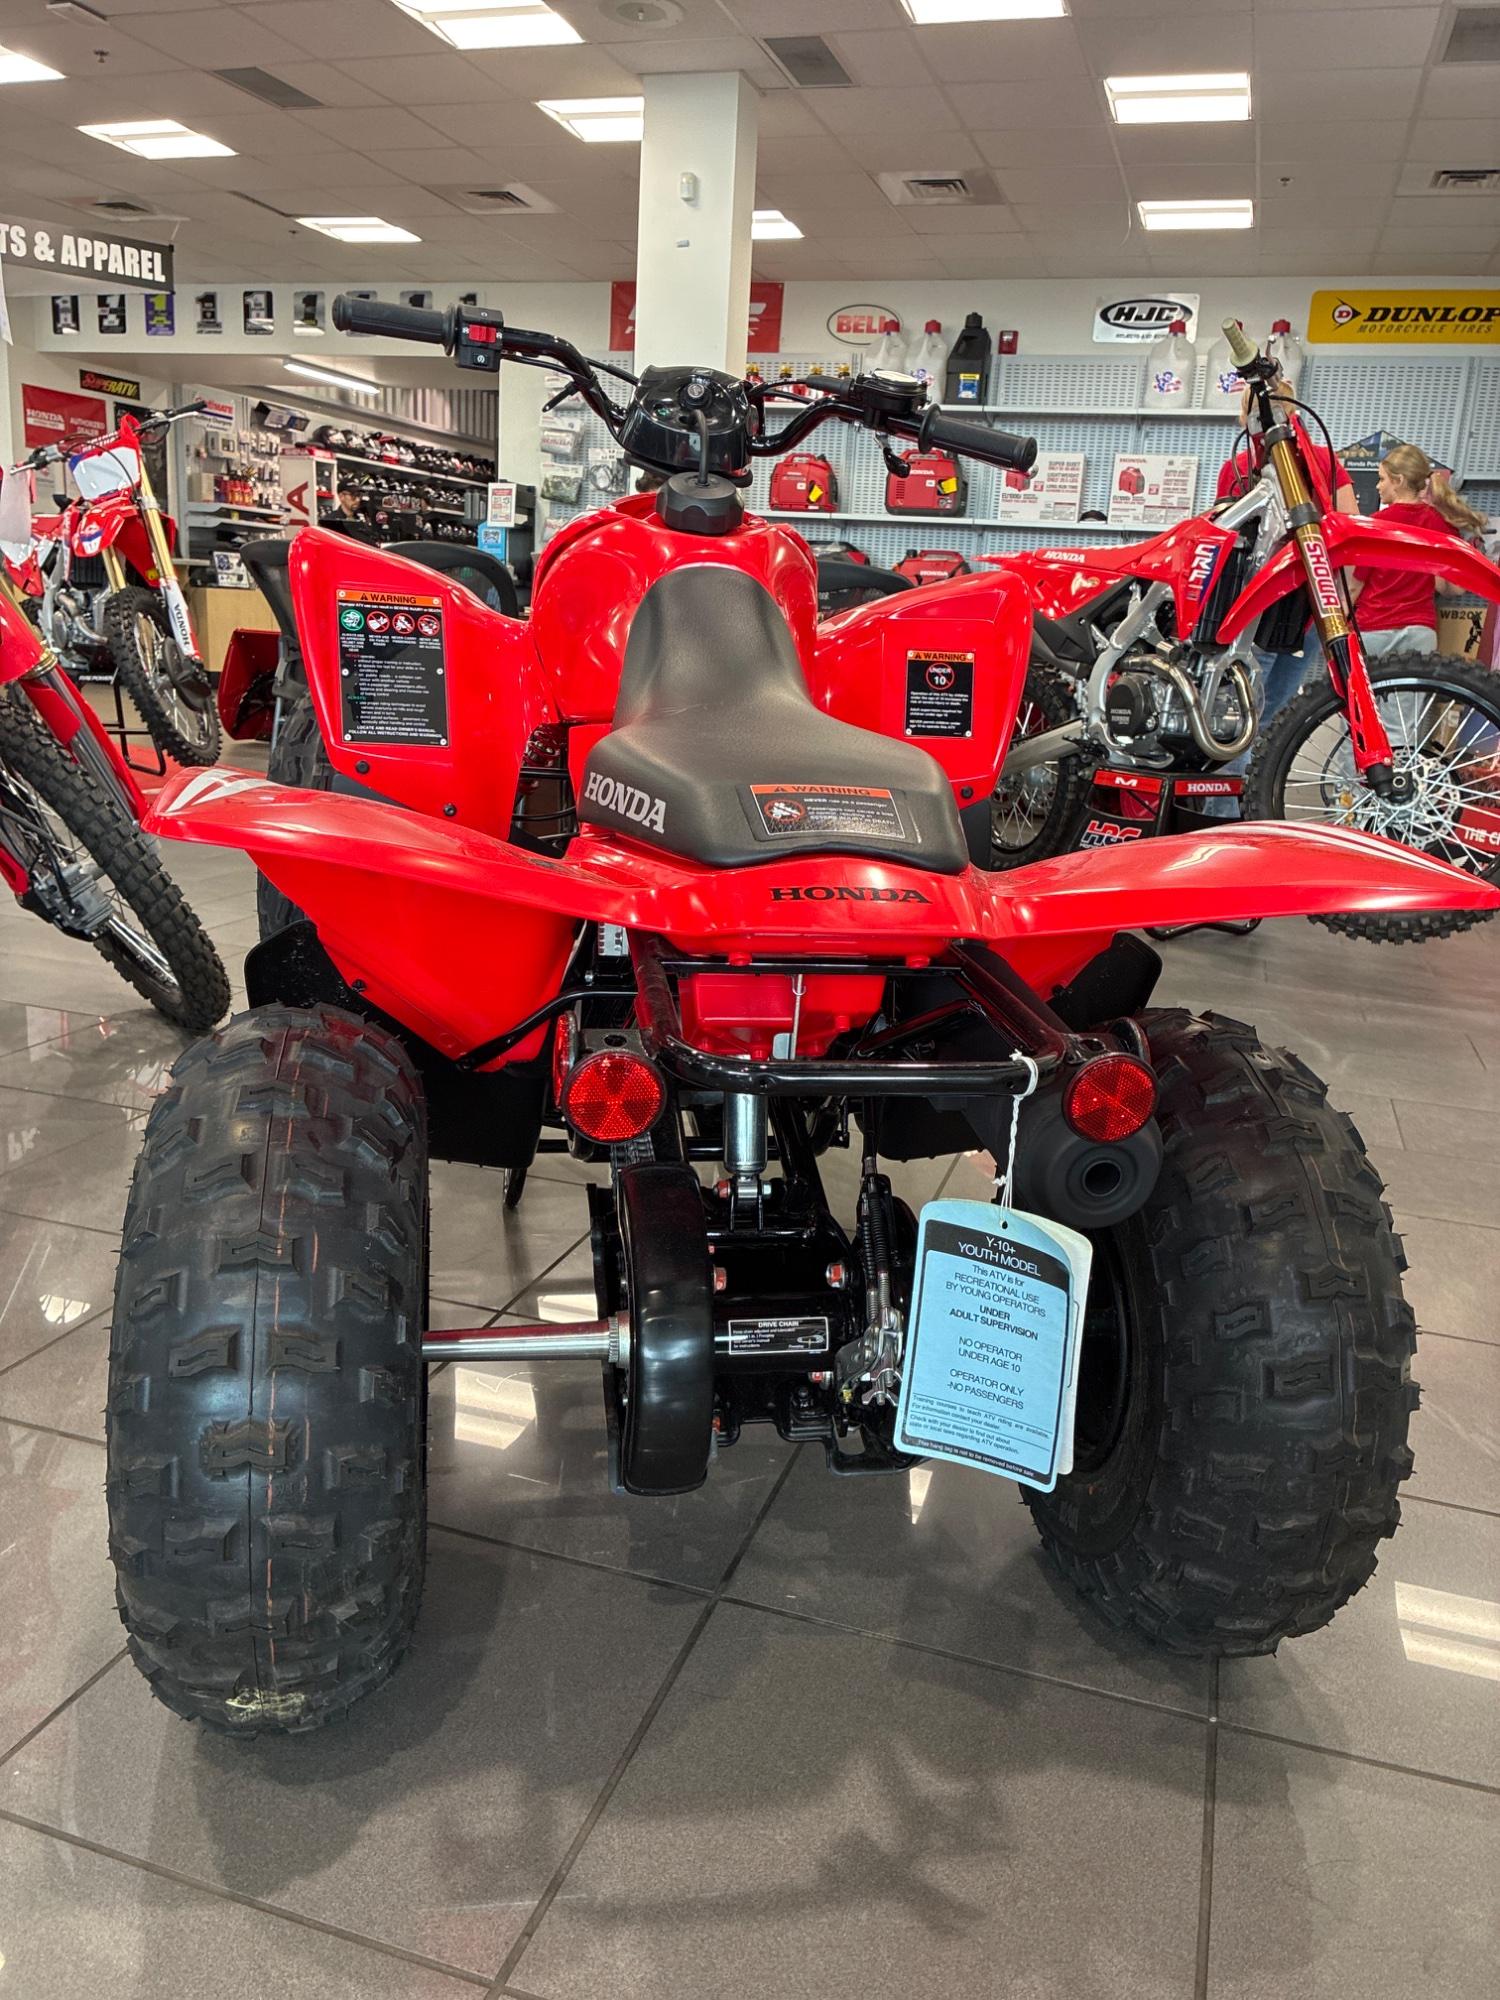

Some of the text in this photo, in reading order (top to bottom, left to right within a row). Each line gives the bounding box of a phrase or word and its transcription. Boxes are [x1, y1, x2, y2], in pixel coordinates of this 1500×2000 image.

[34, 231, 55, 262] &
[61, 235, 166, 282] APPAREL
[1112, 306, 1179, 321] HJC
[1363, 307, 1500, 322] DUNLOP
[1356, 324, 1493, 333] MOTORCYCLE TIRES
[26, 408, 65, 423] HONDA
[1043, 552, 1086, 563] HONDA
[1304, 541, 1341, 608] SHOWA
[370, 593, 417, 604] WARNING
[174, 604, 191, 646] HONDA
[923, 653, 966, 661] WARNING
[934, 676, 946, 685] 10
[792, 785, 871, 796] WARNING
[1187, 783, 1231, 793] HONDA
[584, 771, 668, 834] HONDA
[1464, 827, 1487, 844] THE
[768, 887, 933, 904] HONDA
[986, 1236, 1016, 1254] Y-10+
[958, 1241, 1041, 1277] YOUTH MODEL
[972, 1264, 988, 1277] This
[989, 1270, 1007, 1281] ATV
[1014, 1277, 1025, 1287] for
[954, 1272, 1040, 1305] RECREATIONAL USE
[945, 1281, 1046, 1317] BY YOUNG OPERATORS
[980, 1305, 1010, 1320] UNDER
[949, 1308, 1038, 1340] ADULT SUPERVISION
[959, 1336, 1023, 1362] NO OPERATOR
[959, 1347, 1021, 1373] UNDER AGE 10
[950, 1368, 1024, 1396] OPERATOR ONLY
[964, 1385, 1024, 1409] PASSENGERS
[967, 1408, 982, 1417] teach
[984, 1413, 996, 1421] ATV
[997, 1417, 1012, 1428] riding
[910, 1414, 927, 1423] Check
[928, 1417, 939, 1425] with
[940, 1421, 951, 1429] your
[952, 1423, 969, 1432] dealer
[976, 1429, 986, 1437] find
[986, 1432, 995, 1440] out
[995, 1434, 1010, 1445] about
[956, 1431, 980, 1443] regarding
[981, 1437, 993, 1446] ATV
[930, 1441, 943, 1451] hang
[983, 1456, 1005, 1467] removed
[1006, 1462, 1023, 1473] before
